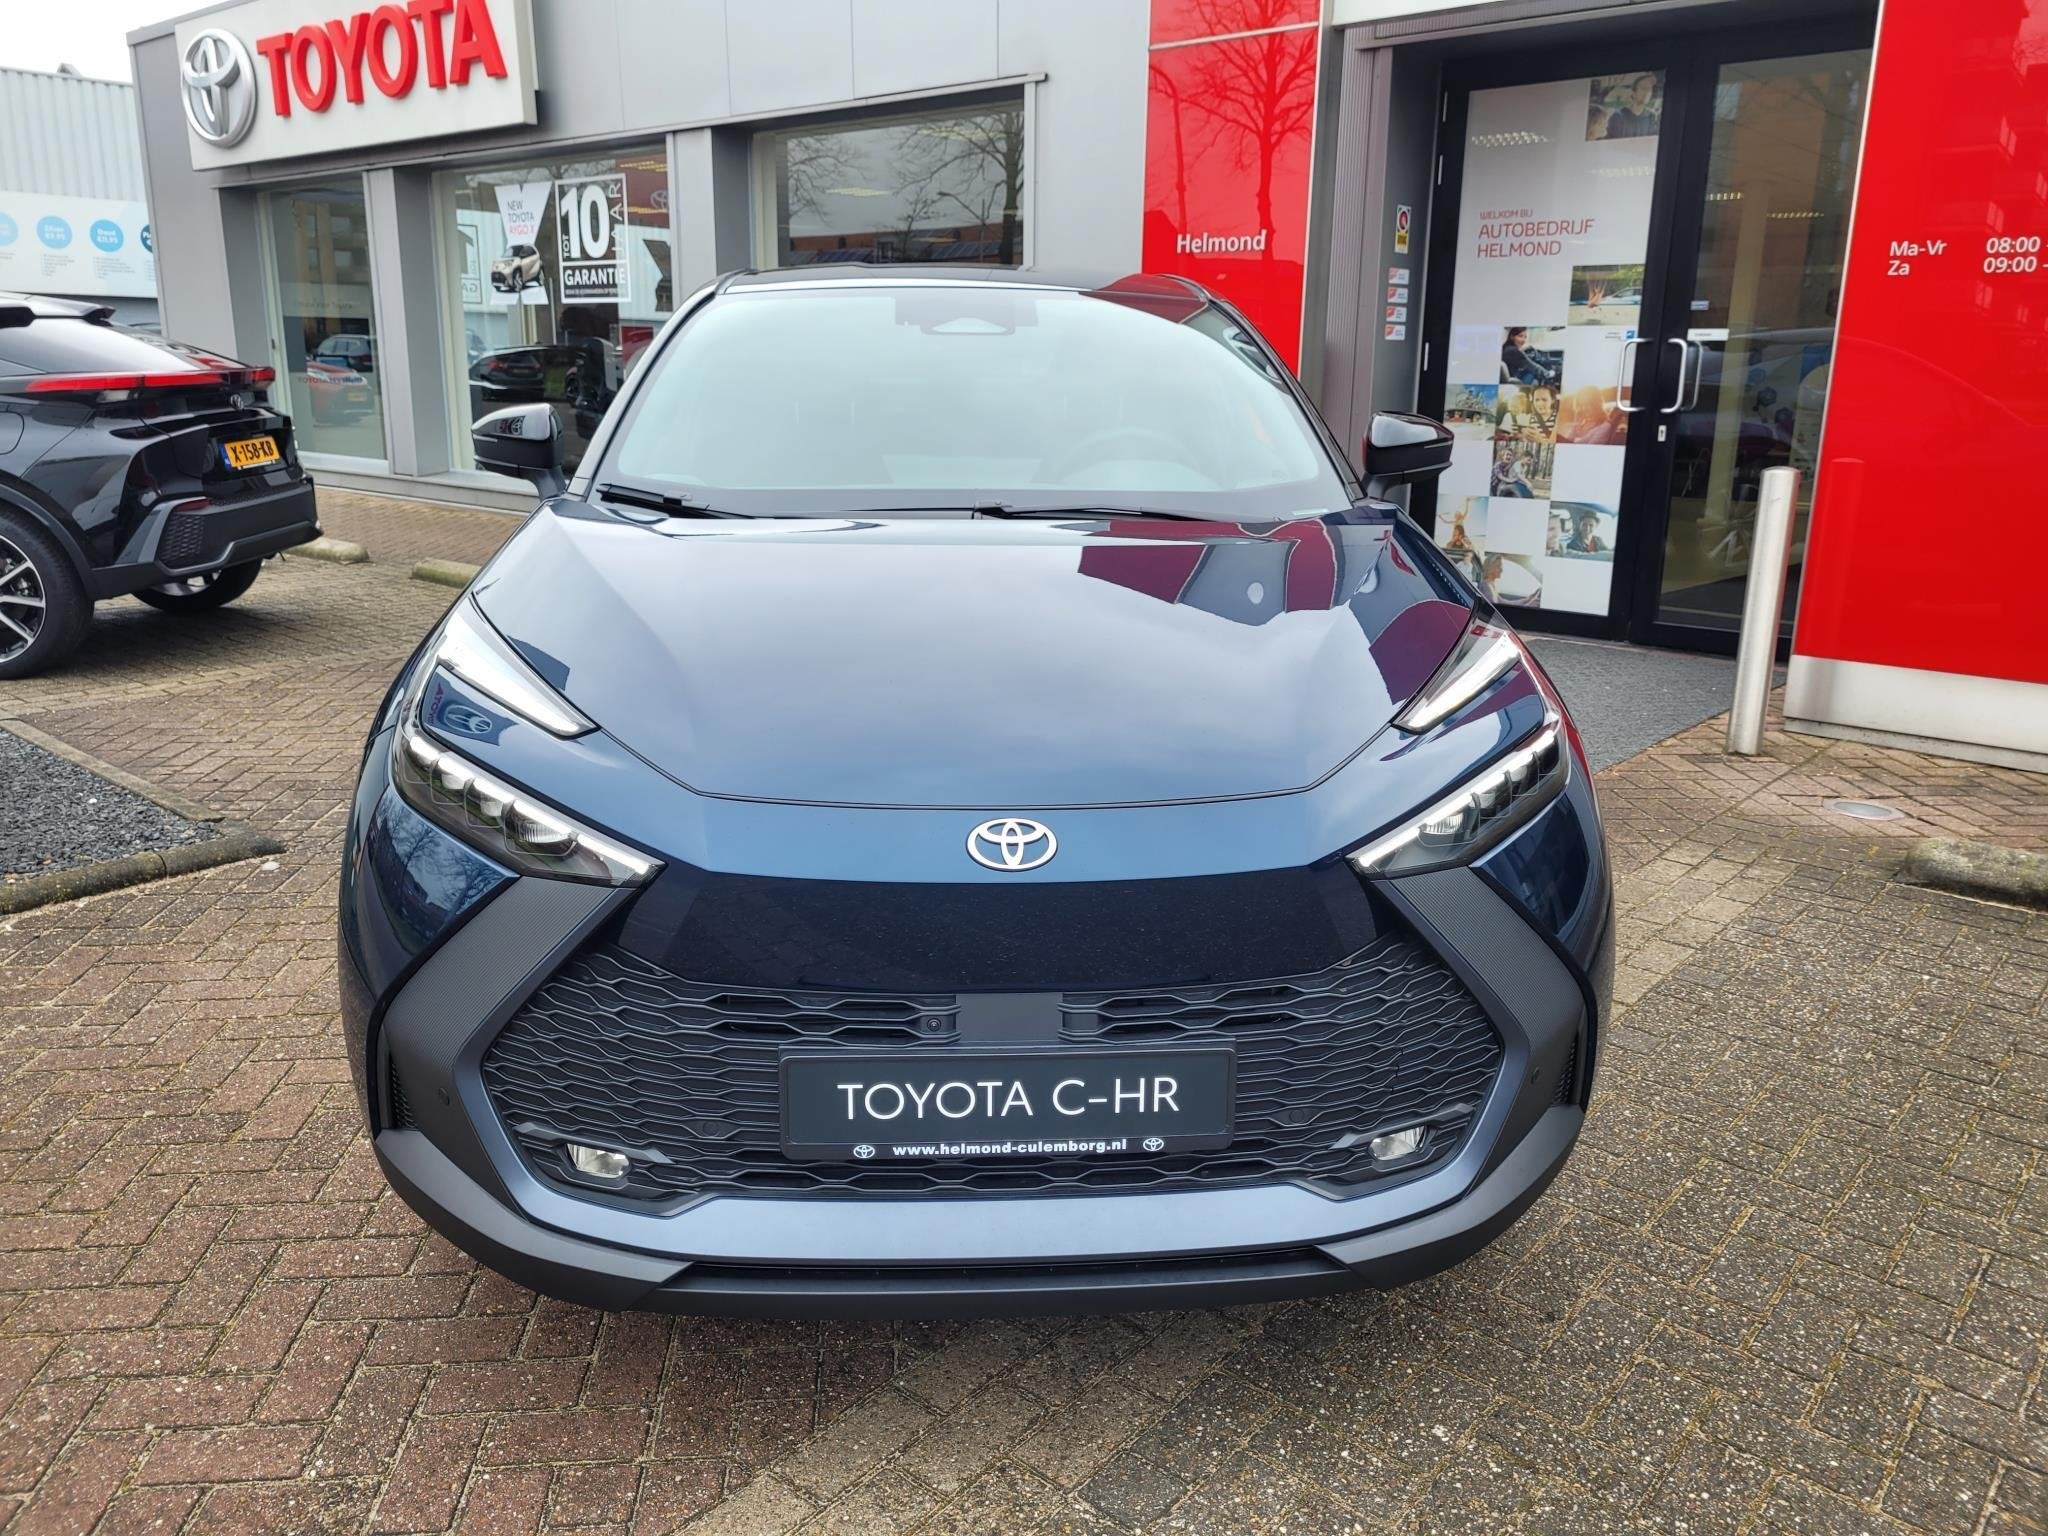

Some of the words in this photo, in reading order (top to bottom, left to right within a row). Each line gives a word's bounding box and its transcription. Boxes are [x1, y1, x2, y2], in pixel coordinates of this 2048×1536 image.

[256, 0, 508, 118] TOYOTA
[507, 200, 523, 210] NEW
[1480, 208, 1518, 220] WELKOM
[1520, 207, 1534, 218] BIJ
[508, 211, 535, 223] TOYOTA
[560, 184, 610, 259] 10
[1478, 218, 1595, 239] AUTOBEDRIJF
[1176, 229, 1268, 254] Helmond
[1477, 241, 1563, 258] HELMOND
[1889, 240, 1947, 257] Ma-Vr
[1986, 236, 2041, 254] 08:00
[1887, 260, 1911, 276] Za
[1983, 256, 2038, 274] 09:00
[564, 267, 628, 286] GARANTIE
[230, 440, 276, 464] X-158-KB
[836, 1080, 1034, 1121] TOYOTA
[1051, 1077, 1181, 1116] C-HR
[892, 1138, 1128, 1156] www.helmond-culemborg.nl
